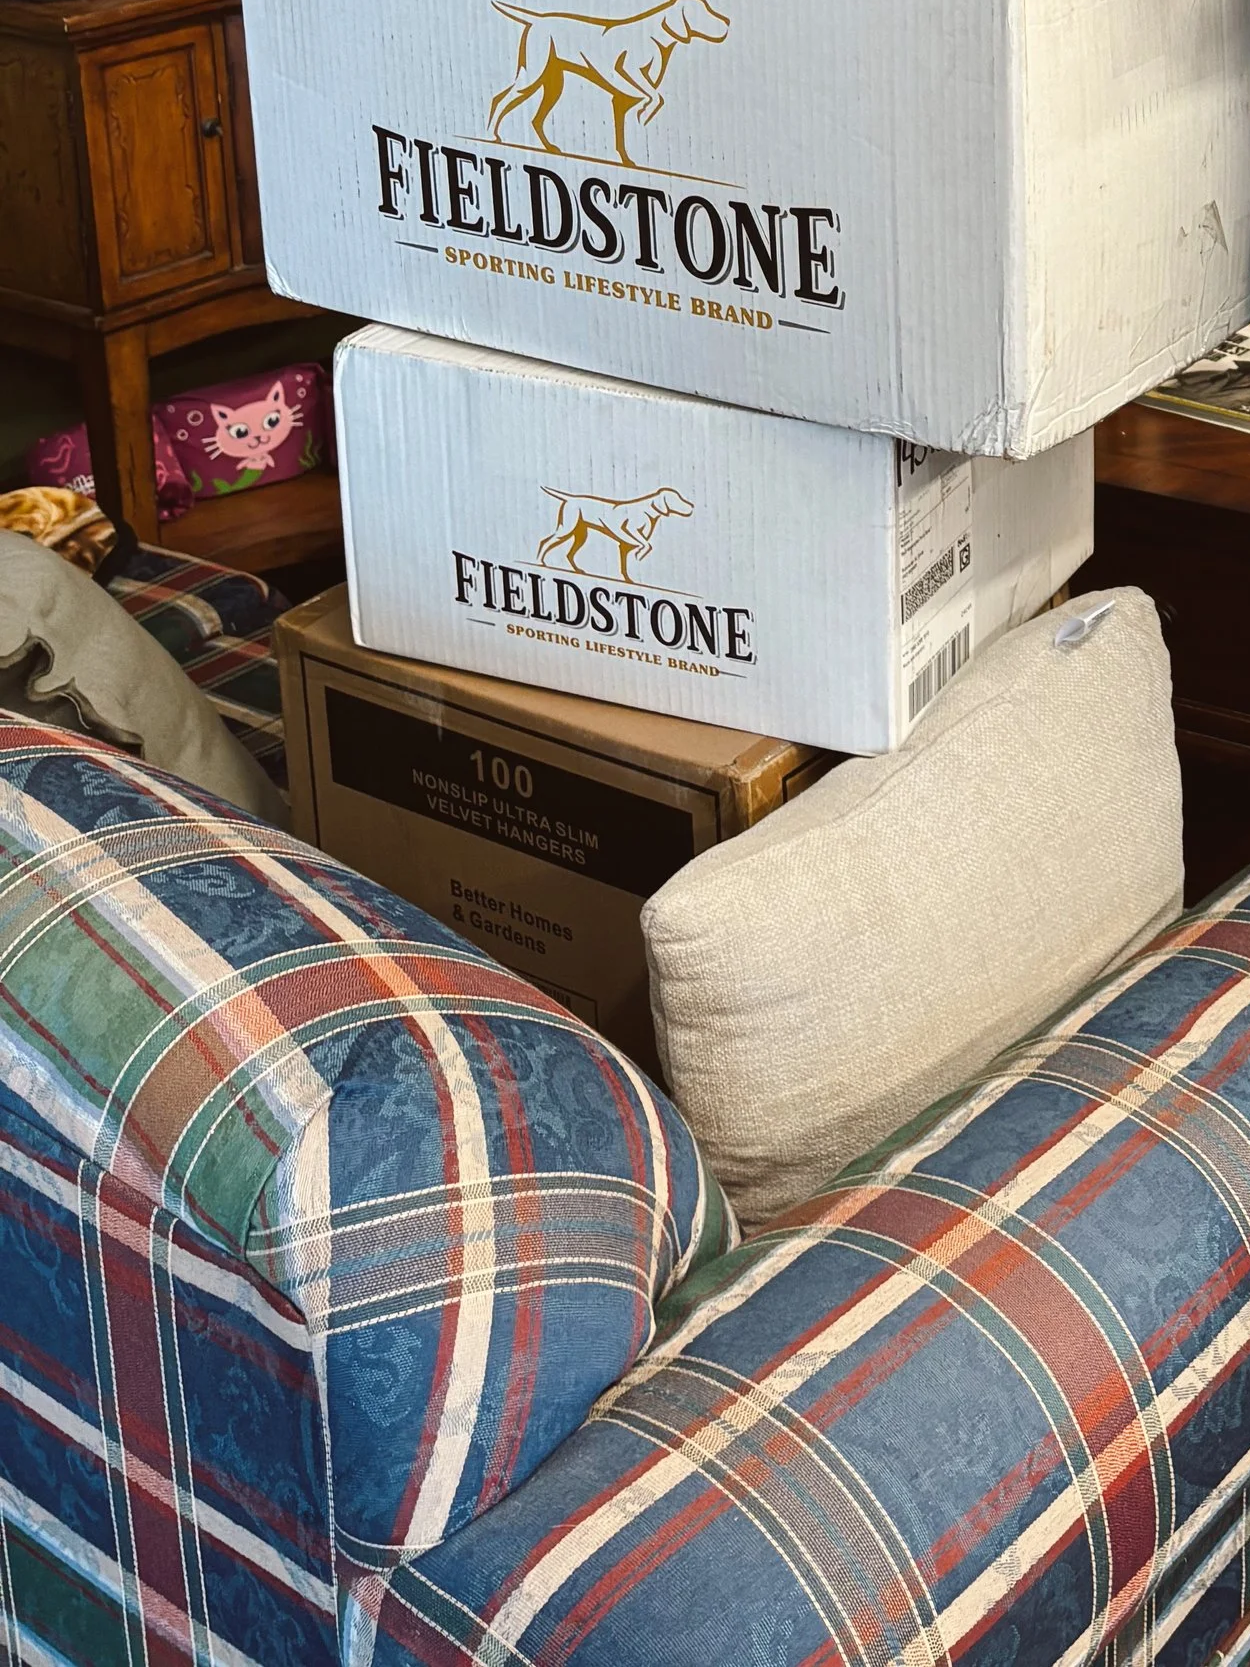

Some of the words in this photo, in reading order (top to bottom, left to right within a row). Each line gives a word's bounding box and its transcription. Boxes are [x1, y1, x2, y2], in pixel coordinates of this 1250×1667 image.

[372, 124, 846, 310] FIELDSTONE
[445, 245, 555, 285] SPORTING
[564, 271, 681, 312] LIFESTYLE
[690, 296, 773, 330] BRAND
[452, 550, 757, 665] FIELDSTONE
[506, 623, 580, 648] SPORTING
[586, 641, 662, 665] LIFESTYLE
[668, 658, 720, 677] BRAND
[412, 768, 488, 807] NONSLIP
[492, 797, 551, 833] ULTRA
[556, 821, 600, 850] SLIM
[469, 749, 533, 798] 100
[426, 794, 492, 831] VELVET
[497, 820, 587, 866] HANGERS
[450, 878, 505, 914] Better
[511, 901, 574, 942] Homes
[452, 903, 465, 923] &
[469, 909, 547, 956] Gardens
